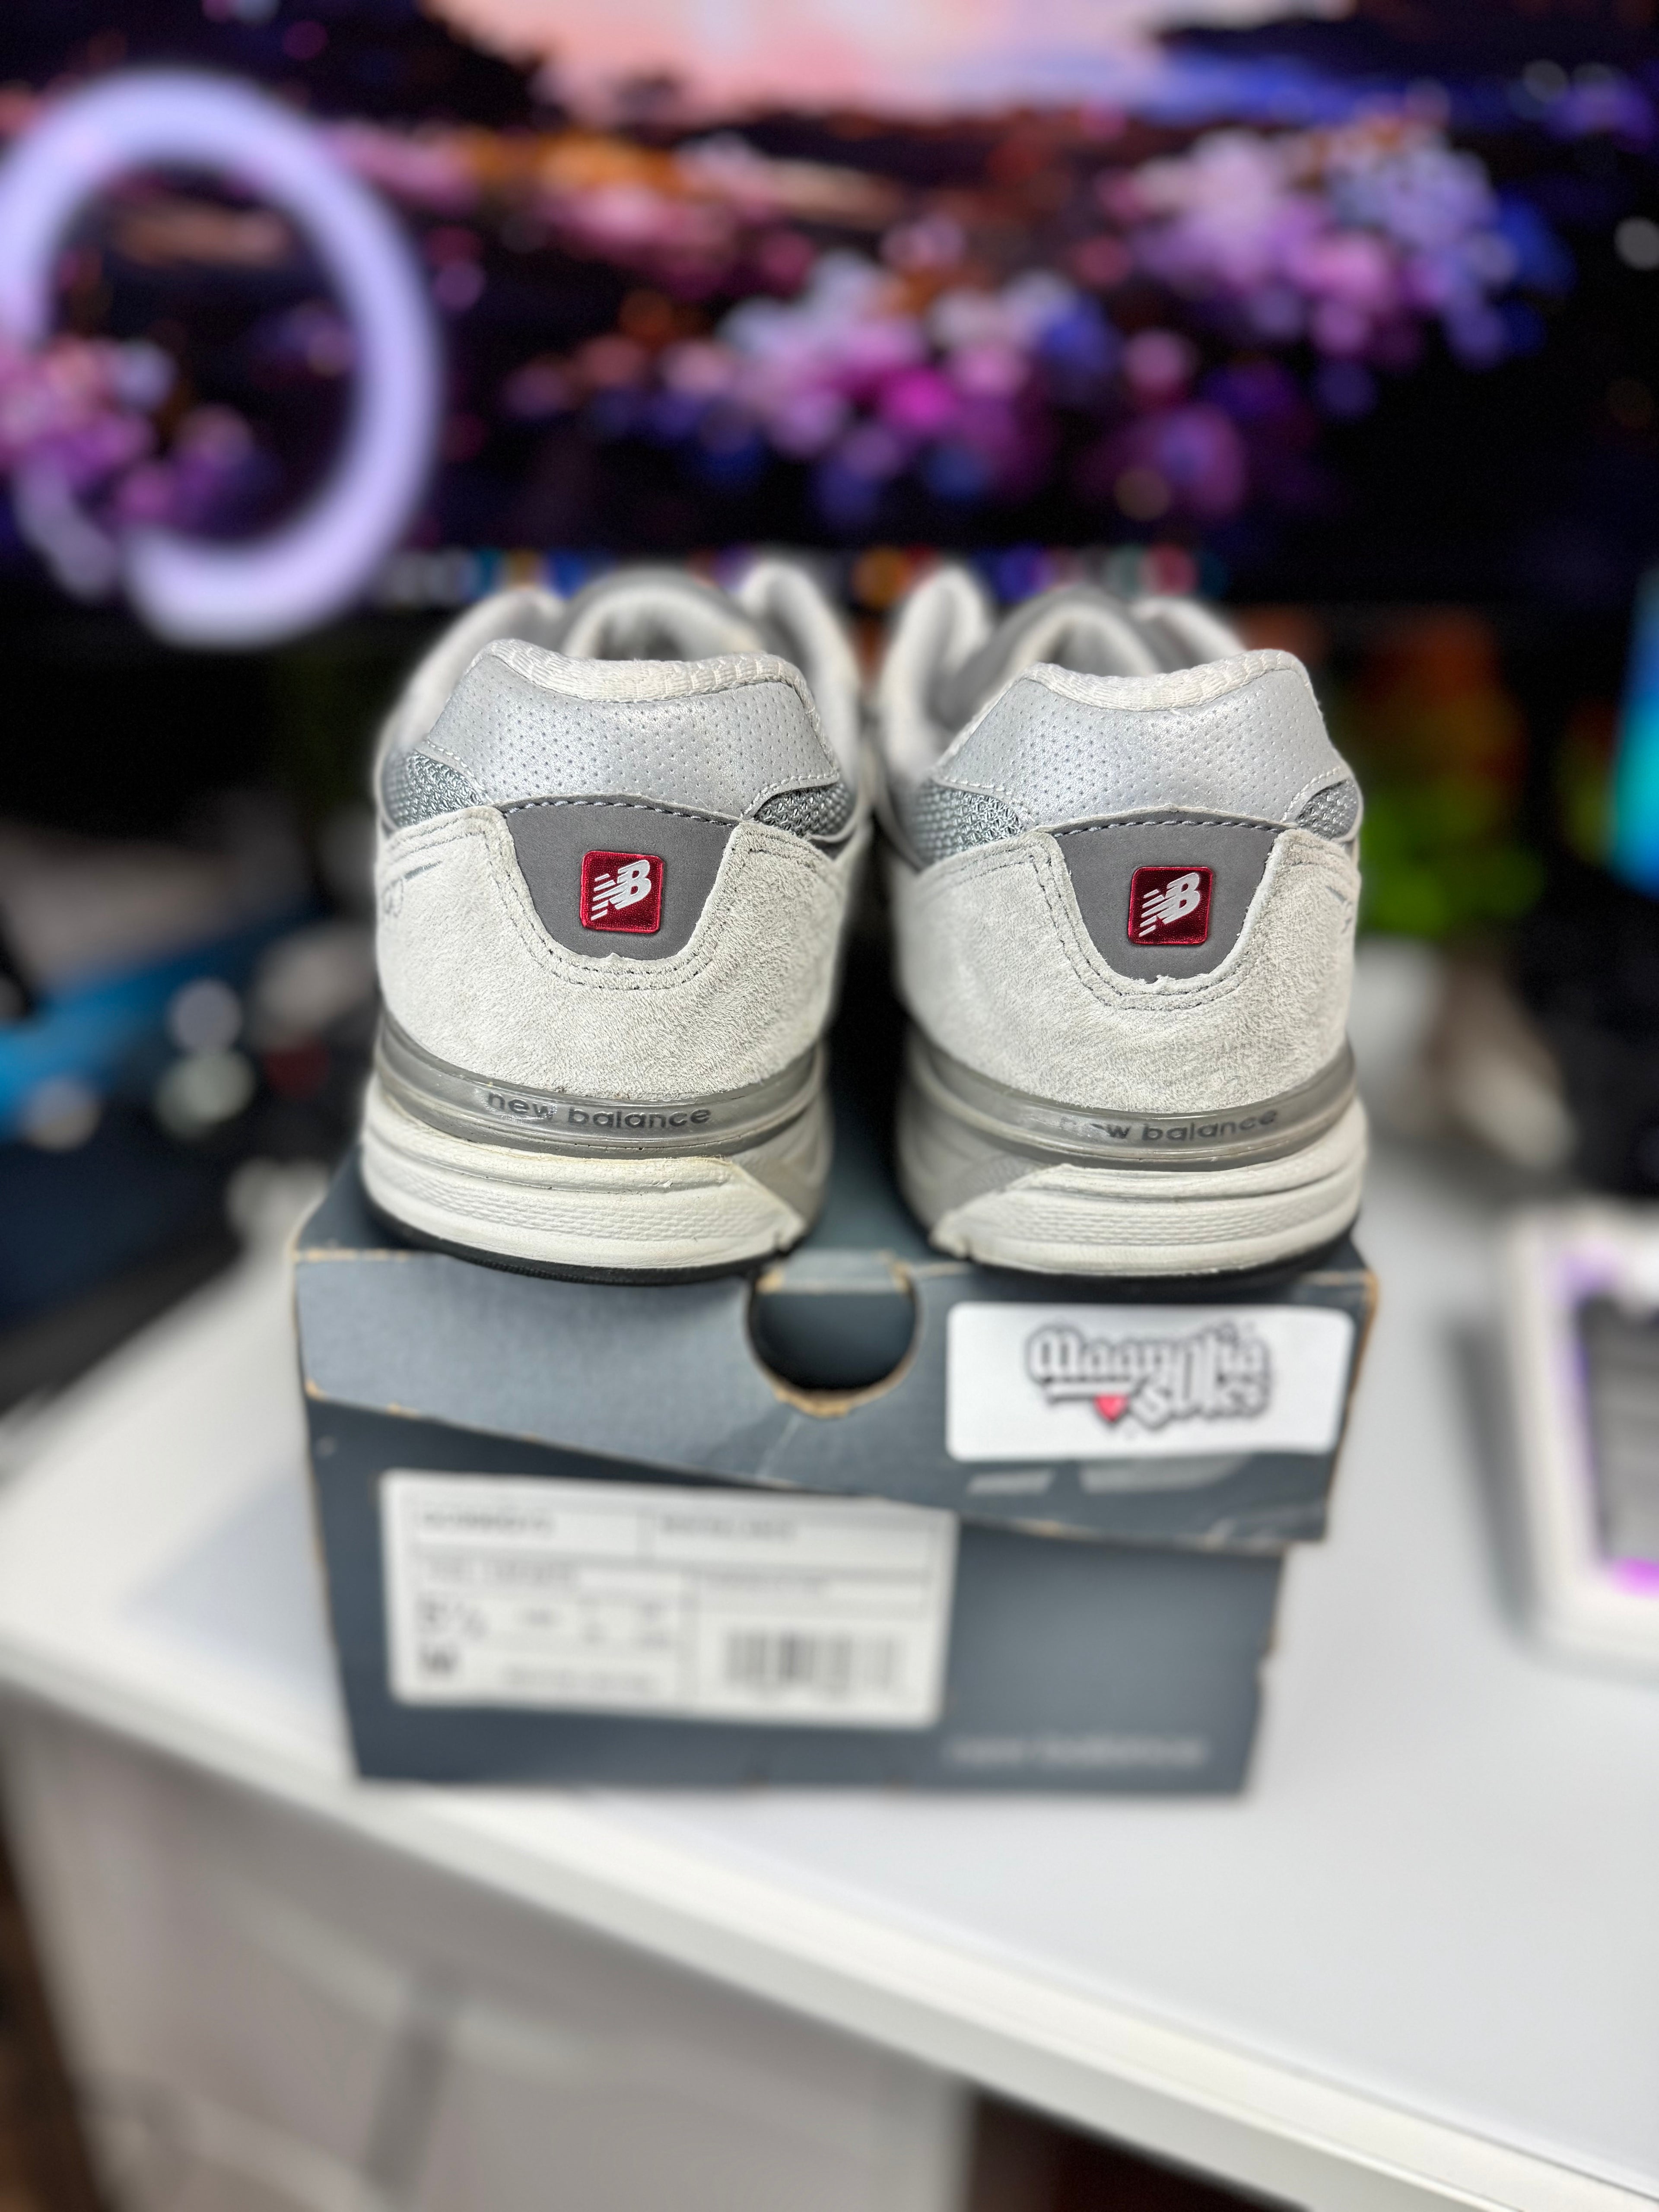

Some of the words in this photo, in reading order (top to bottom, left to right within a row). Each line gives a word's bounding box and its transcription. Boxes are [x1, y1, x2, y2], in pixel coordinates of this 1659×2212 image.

[488, 1091, 557, 1121] new
[567, 1106, 712, 1128] balance
[1142, 1109, 1277, 1141] balance
